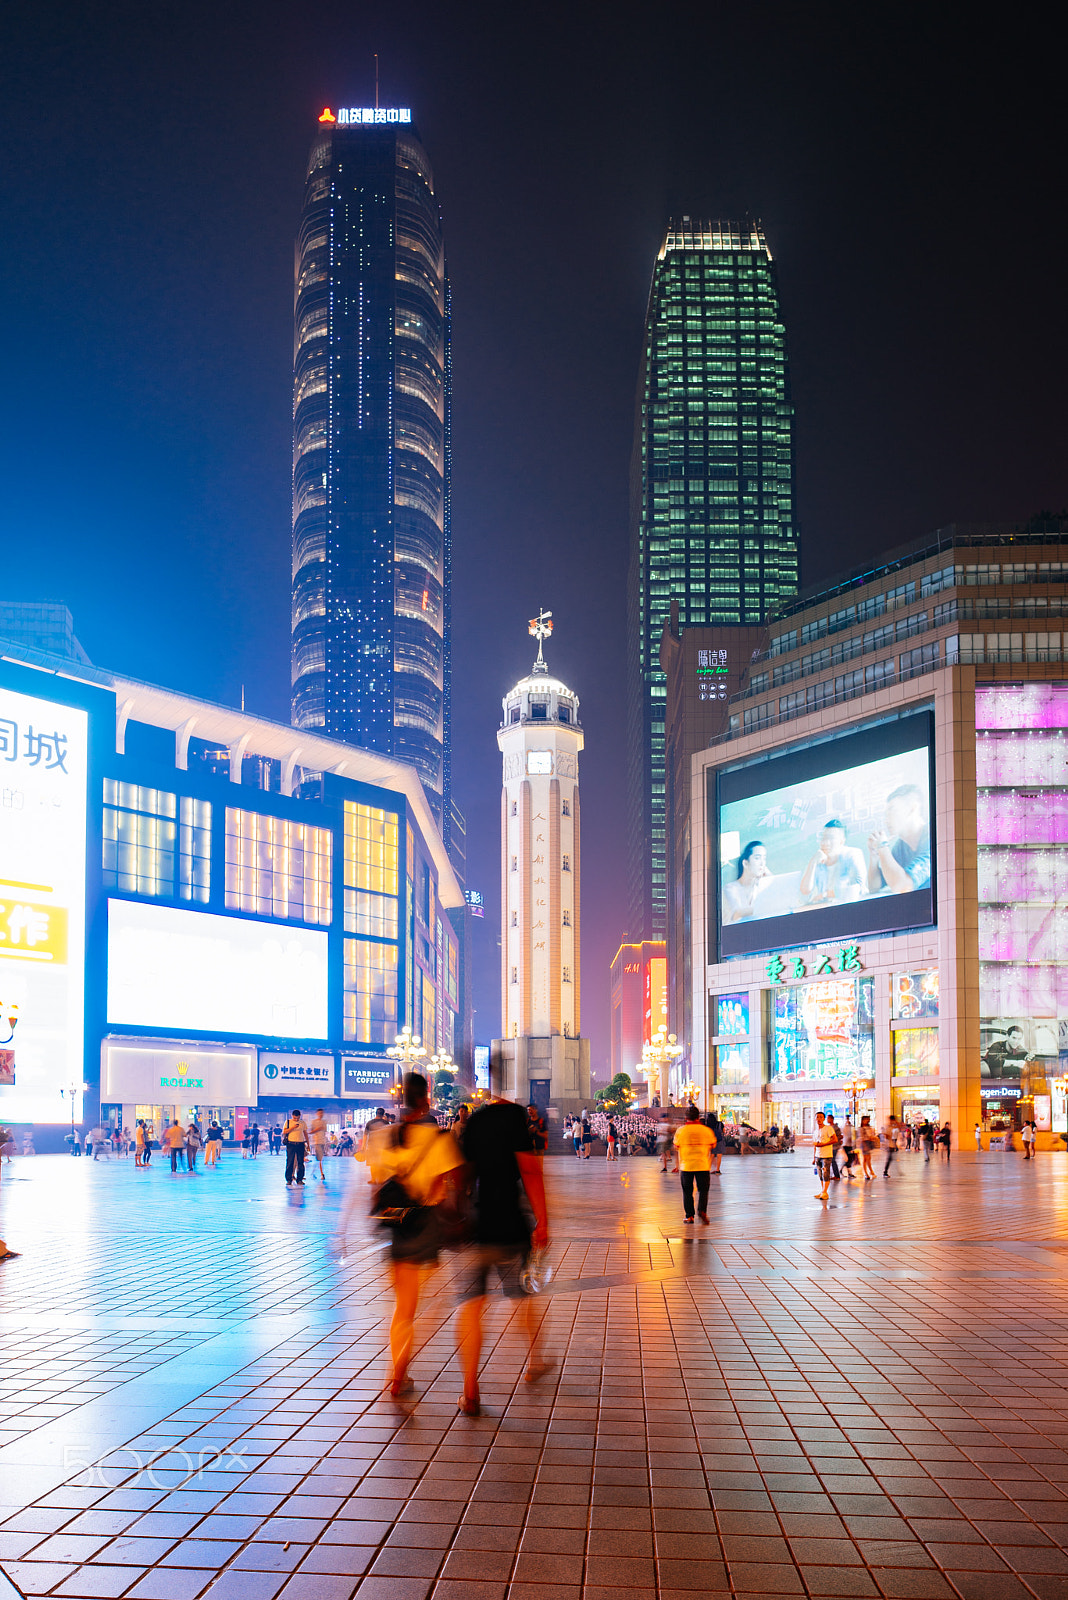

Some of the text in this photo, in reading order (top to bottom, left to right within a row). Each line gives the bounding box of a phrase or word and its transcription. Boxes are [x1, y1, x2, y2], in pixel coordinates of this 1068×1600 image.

[0, 905, 49, 946] 作
[280, 1065, 329, 1076] 中国农业银行
[348, 1070, 390, 1078] STARBUCKS
[160, 1077, 204, 1088] ROLEX
